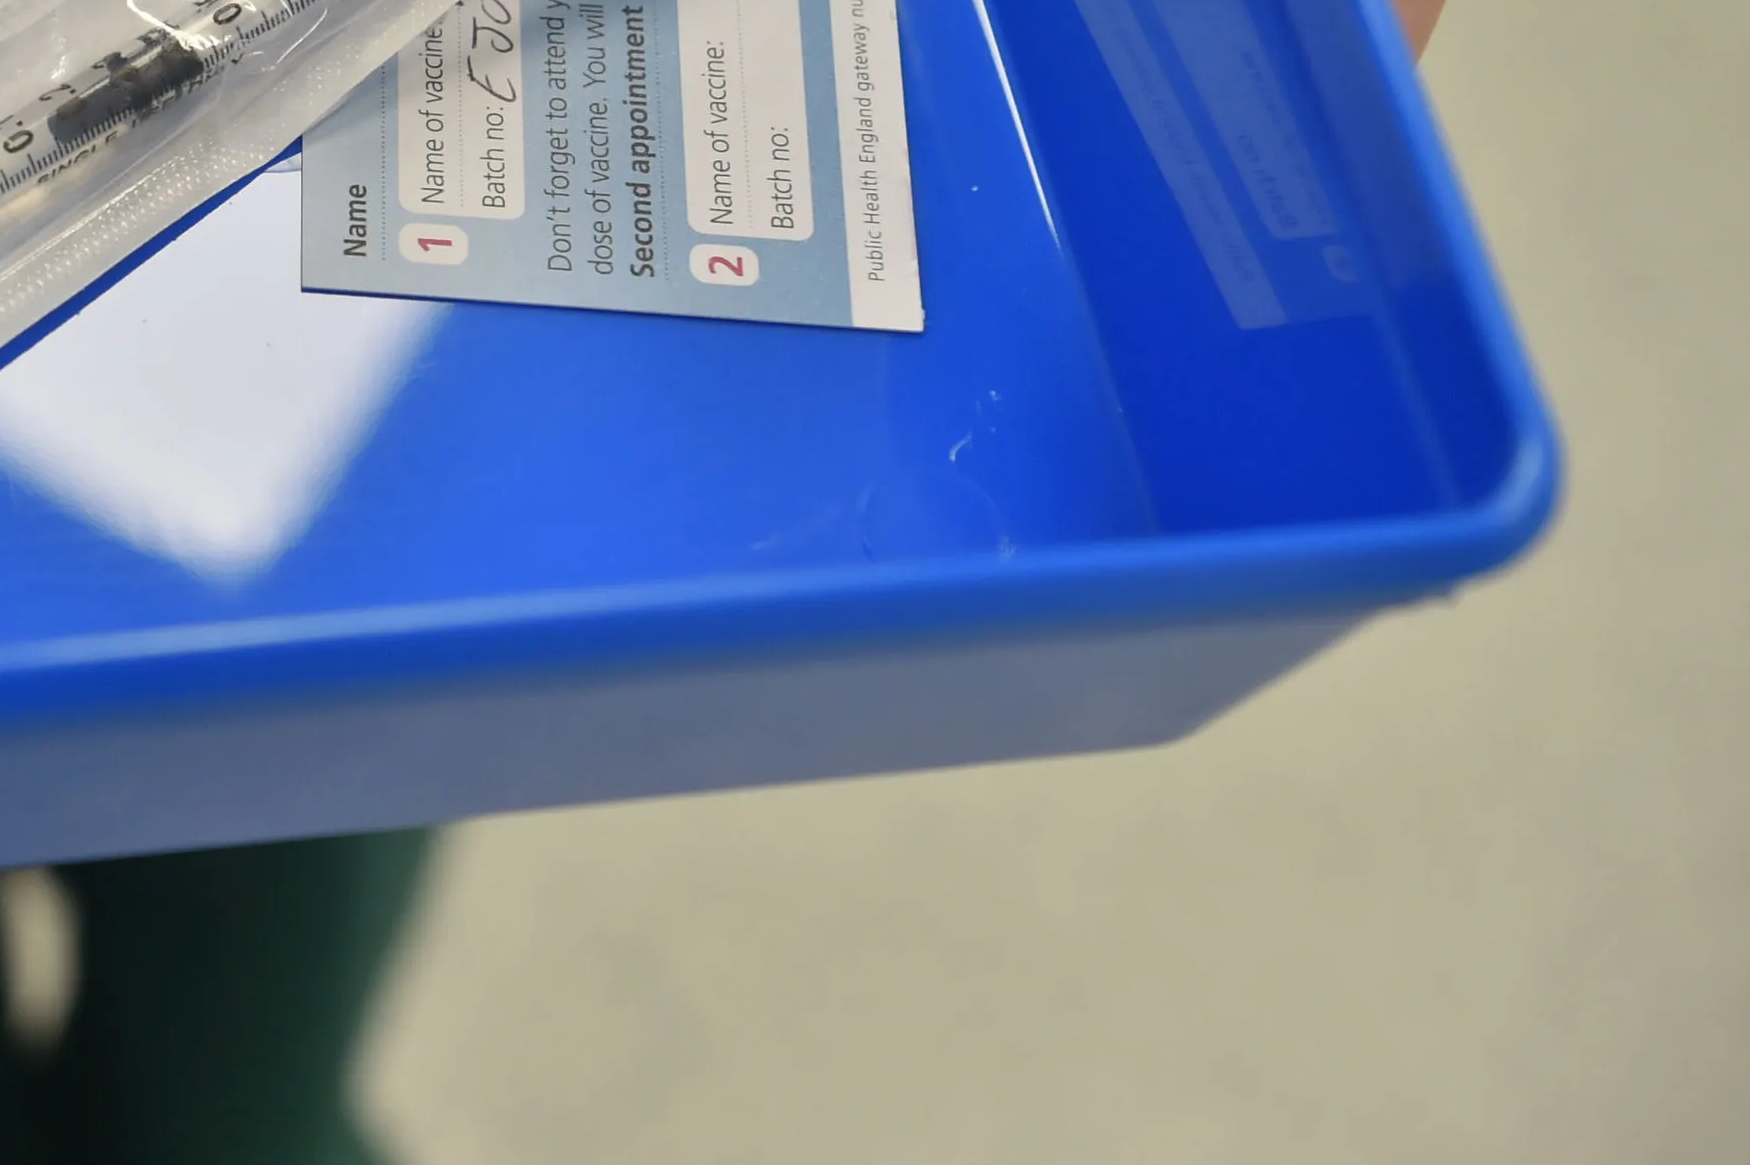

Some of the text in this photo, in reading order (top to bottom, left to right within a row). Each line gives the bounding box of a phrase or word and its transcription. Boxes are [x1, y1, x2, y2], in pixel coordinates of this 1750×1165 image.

[540, 16, 567, 91] attend
[578, 5, 605, 43] will
[851, 22, 875, 92] gateway
[583, 46, 606, 89] You
[622, 5, 656, 175] appointment
[418, 108, 445, 134] of
[548, 95, 568, 123] to
[582, 97, 611, 184] vaccine.
[701, 39, 734, 225] Name of vaccine:
[856, 96, 881, 164] England
[421, 138, 445, 204] Name
[480, 106, 506, 209] Batch no:
[543, 128, 575, 201] forget
[765, 125, 795, 230] Batch no:
[343, 183, 368, 258] Name
[584, 188, 611, 214] of
[625, 181, 655, 278] Second
[858, 169, 882, 229] Health
[416, 237, 453, 252] 1
[547, 206, 573, 272] Don't
[586, 220, 613, 275] dose
[708, 255, 744, 277] 2
[865, 229, 886, 282] Public
